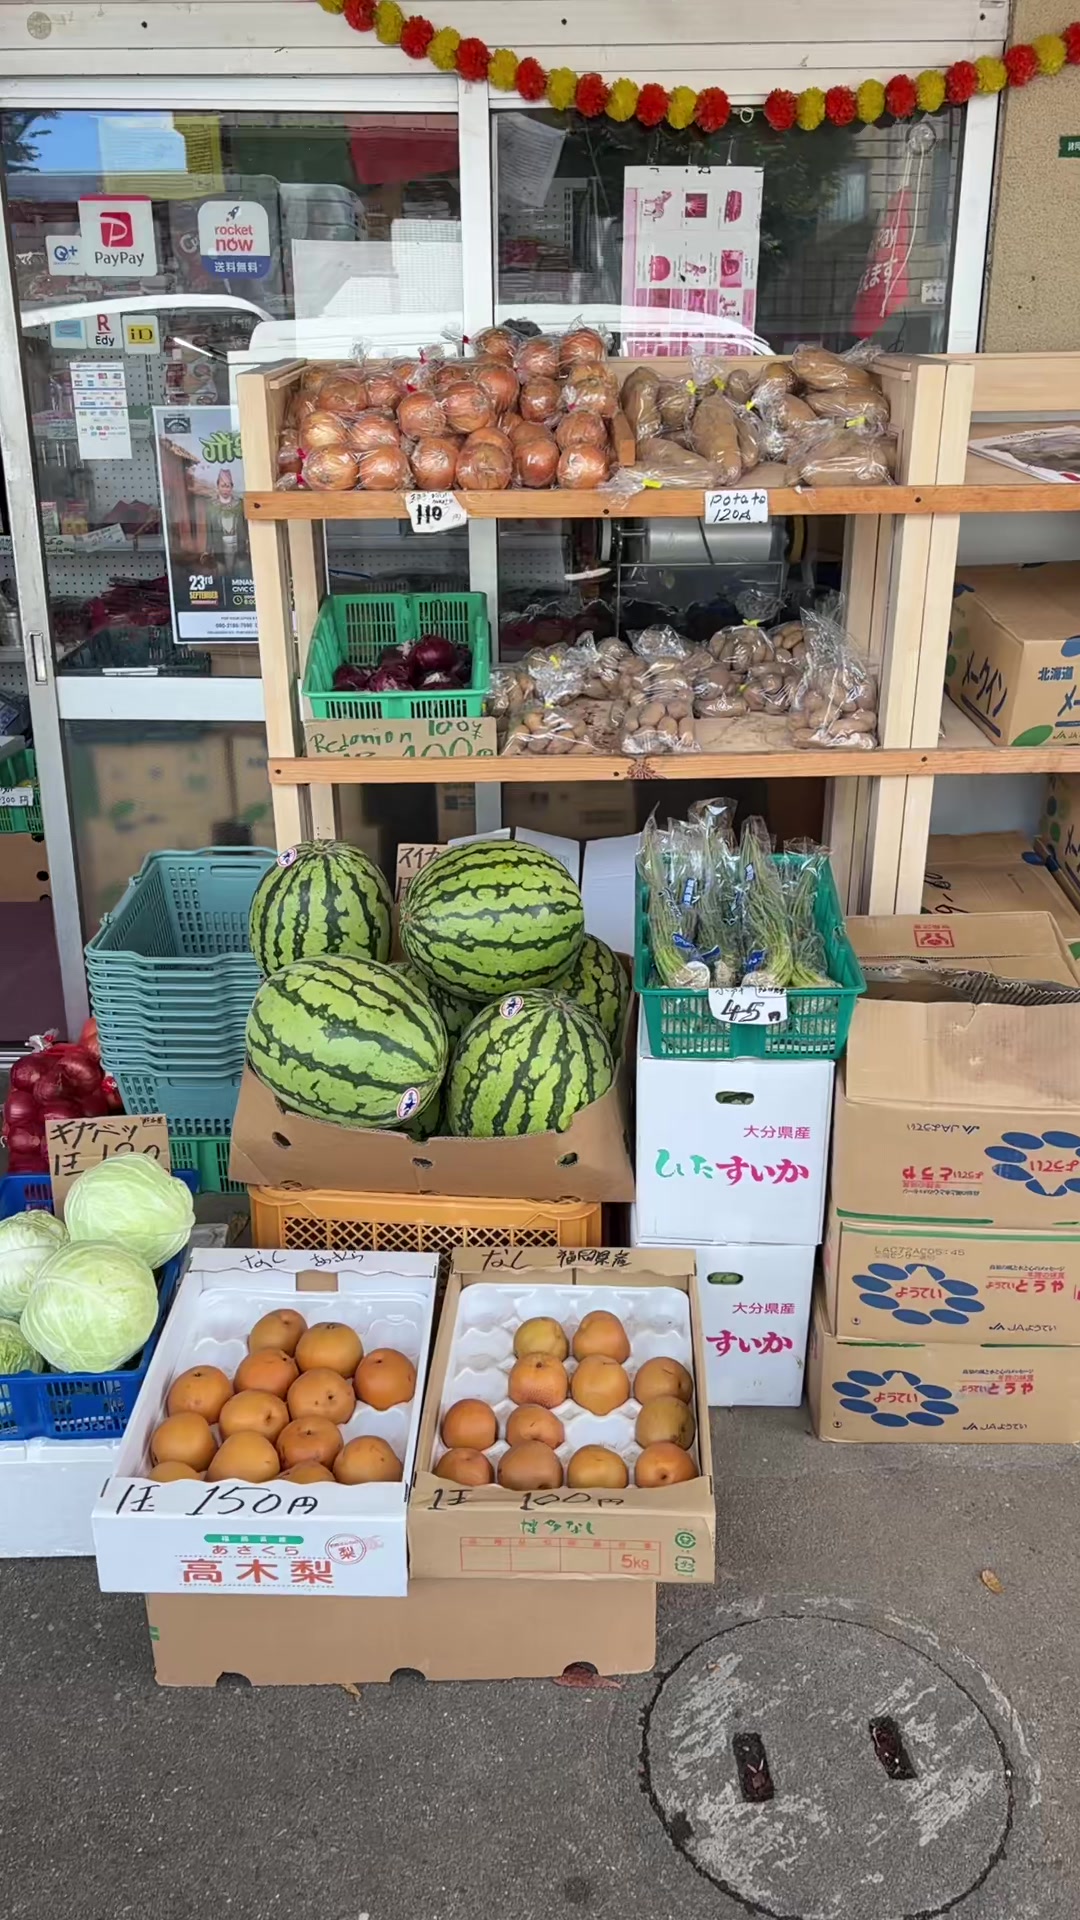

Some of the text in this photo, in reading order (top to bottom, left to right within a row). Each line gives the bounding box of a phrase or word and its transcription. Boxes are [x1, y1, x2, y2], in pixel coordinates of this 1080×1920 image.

[214, 224, 253, 236] rocket
[215, 238, 253, 251] now
[94, 251, 145, 267] PayPay
[214, 261, 258, 273] 送料無料
[96, 314, 111, 332] R
[130, 328, 153, 340] iD
[95, 335, 115, 347] Edy
[189, 575, 213, 590] 23rd
[1037, 666, 1074, 681] 北海道
[744, 1125, 811, 1139] 大分県産
[1030, 1159, 1080, 1172] ようてい
[895, 1286, 942, 1299] ようてい
[732, 1302, 795, 1314] 大分県産
[706, 1329, 793, 1357] すいか
[874, 1391, 918, 1403] ようてい
[185, 1486, 319, 1516] 150円
[212, 1545, 299, 1556] あさくら
[338, 1546, 356, 1560] 梨
[621, 1554, 650, 1570] 5kg
[180, 1558, 334, 1585] 高木梨
